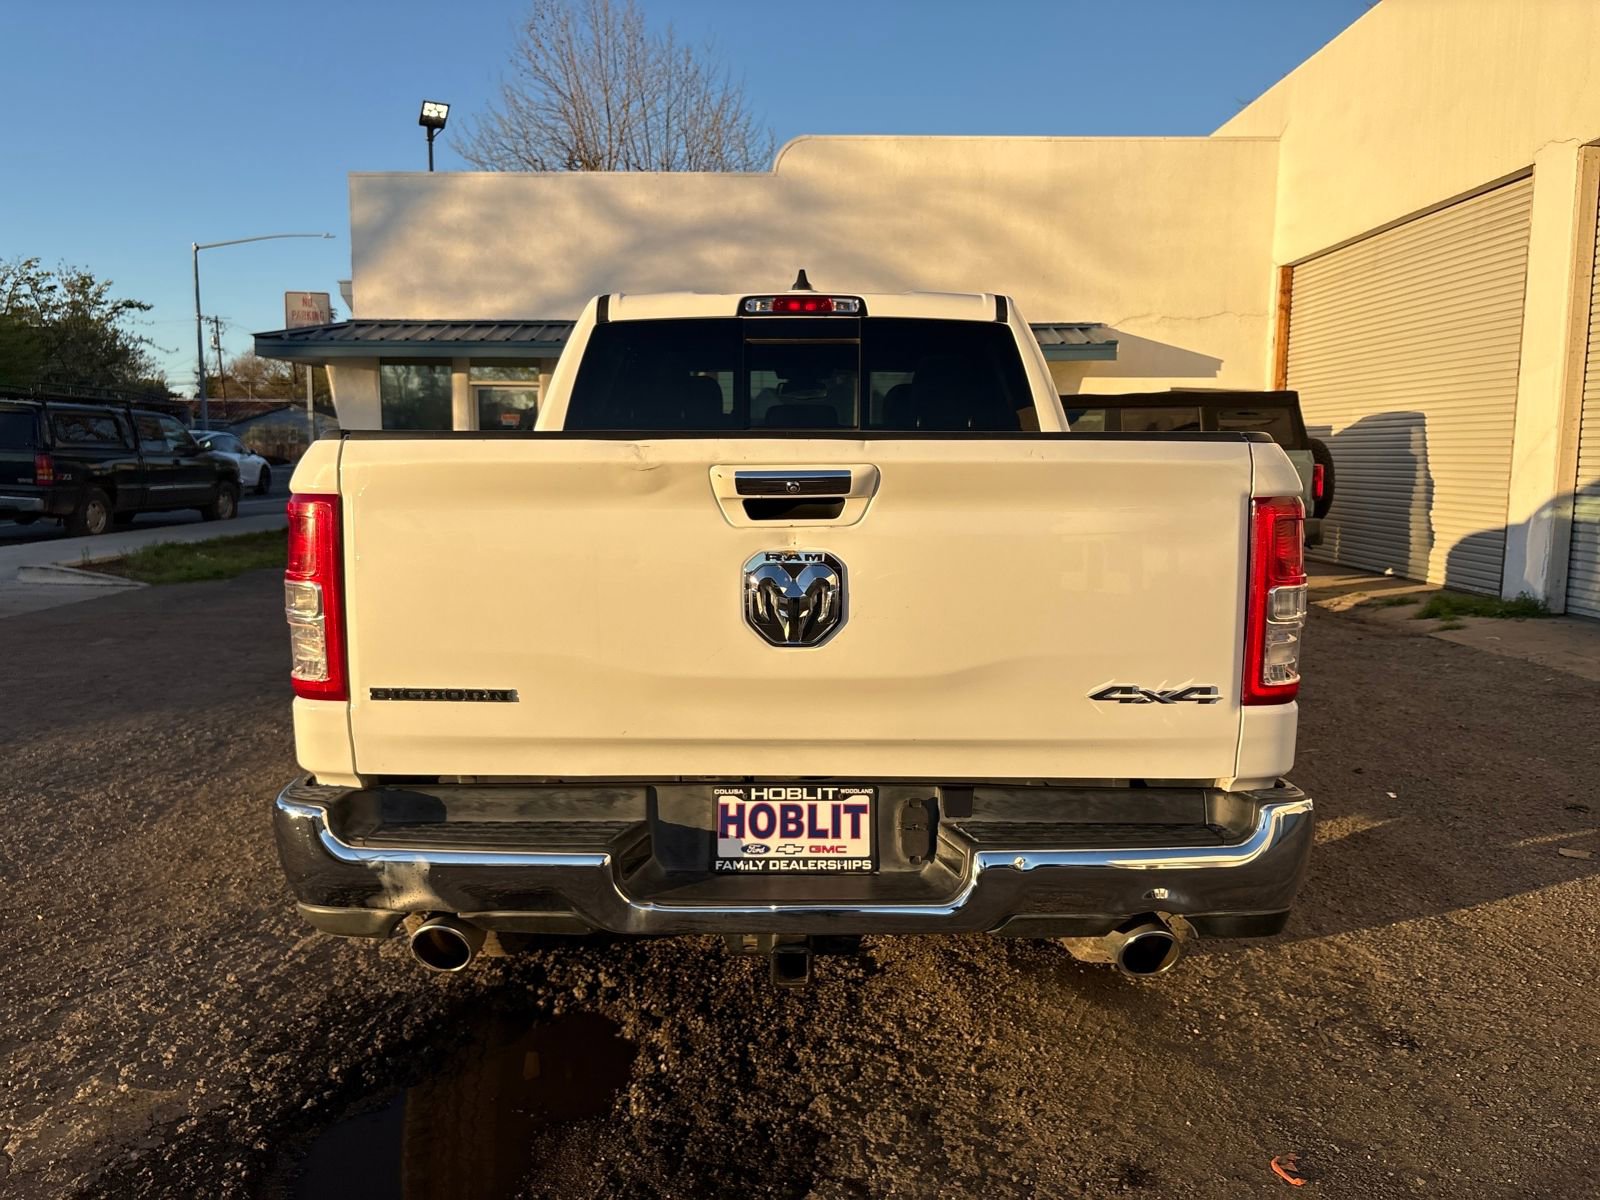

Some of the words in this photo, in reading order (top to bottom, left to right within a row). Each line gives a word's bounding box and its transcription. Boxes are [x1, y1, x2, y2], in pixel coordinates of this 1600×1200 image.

[302, 296, 313, 307] NO
[292, 310, 325, 321] PARKING
[764, 553, 824, 562] RAM
[750, 787, 839, 801] HOBLIT
[718, 803, 869, 840] HOBLIT
[808, 845, 848, 854] GMC
[715, 860, 766, 871] FAMILY
[769, 860, 872, 870] DEALERSHIPS
